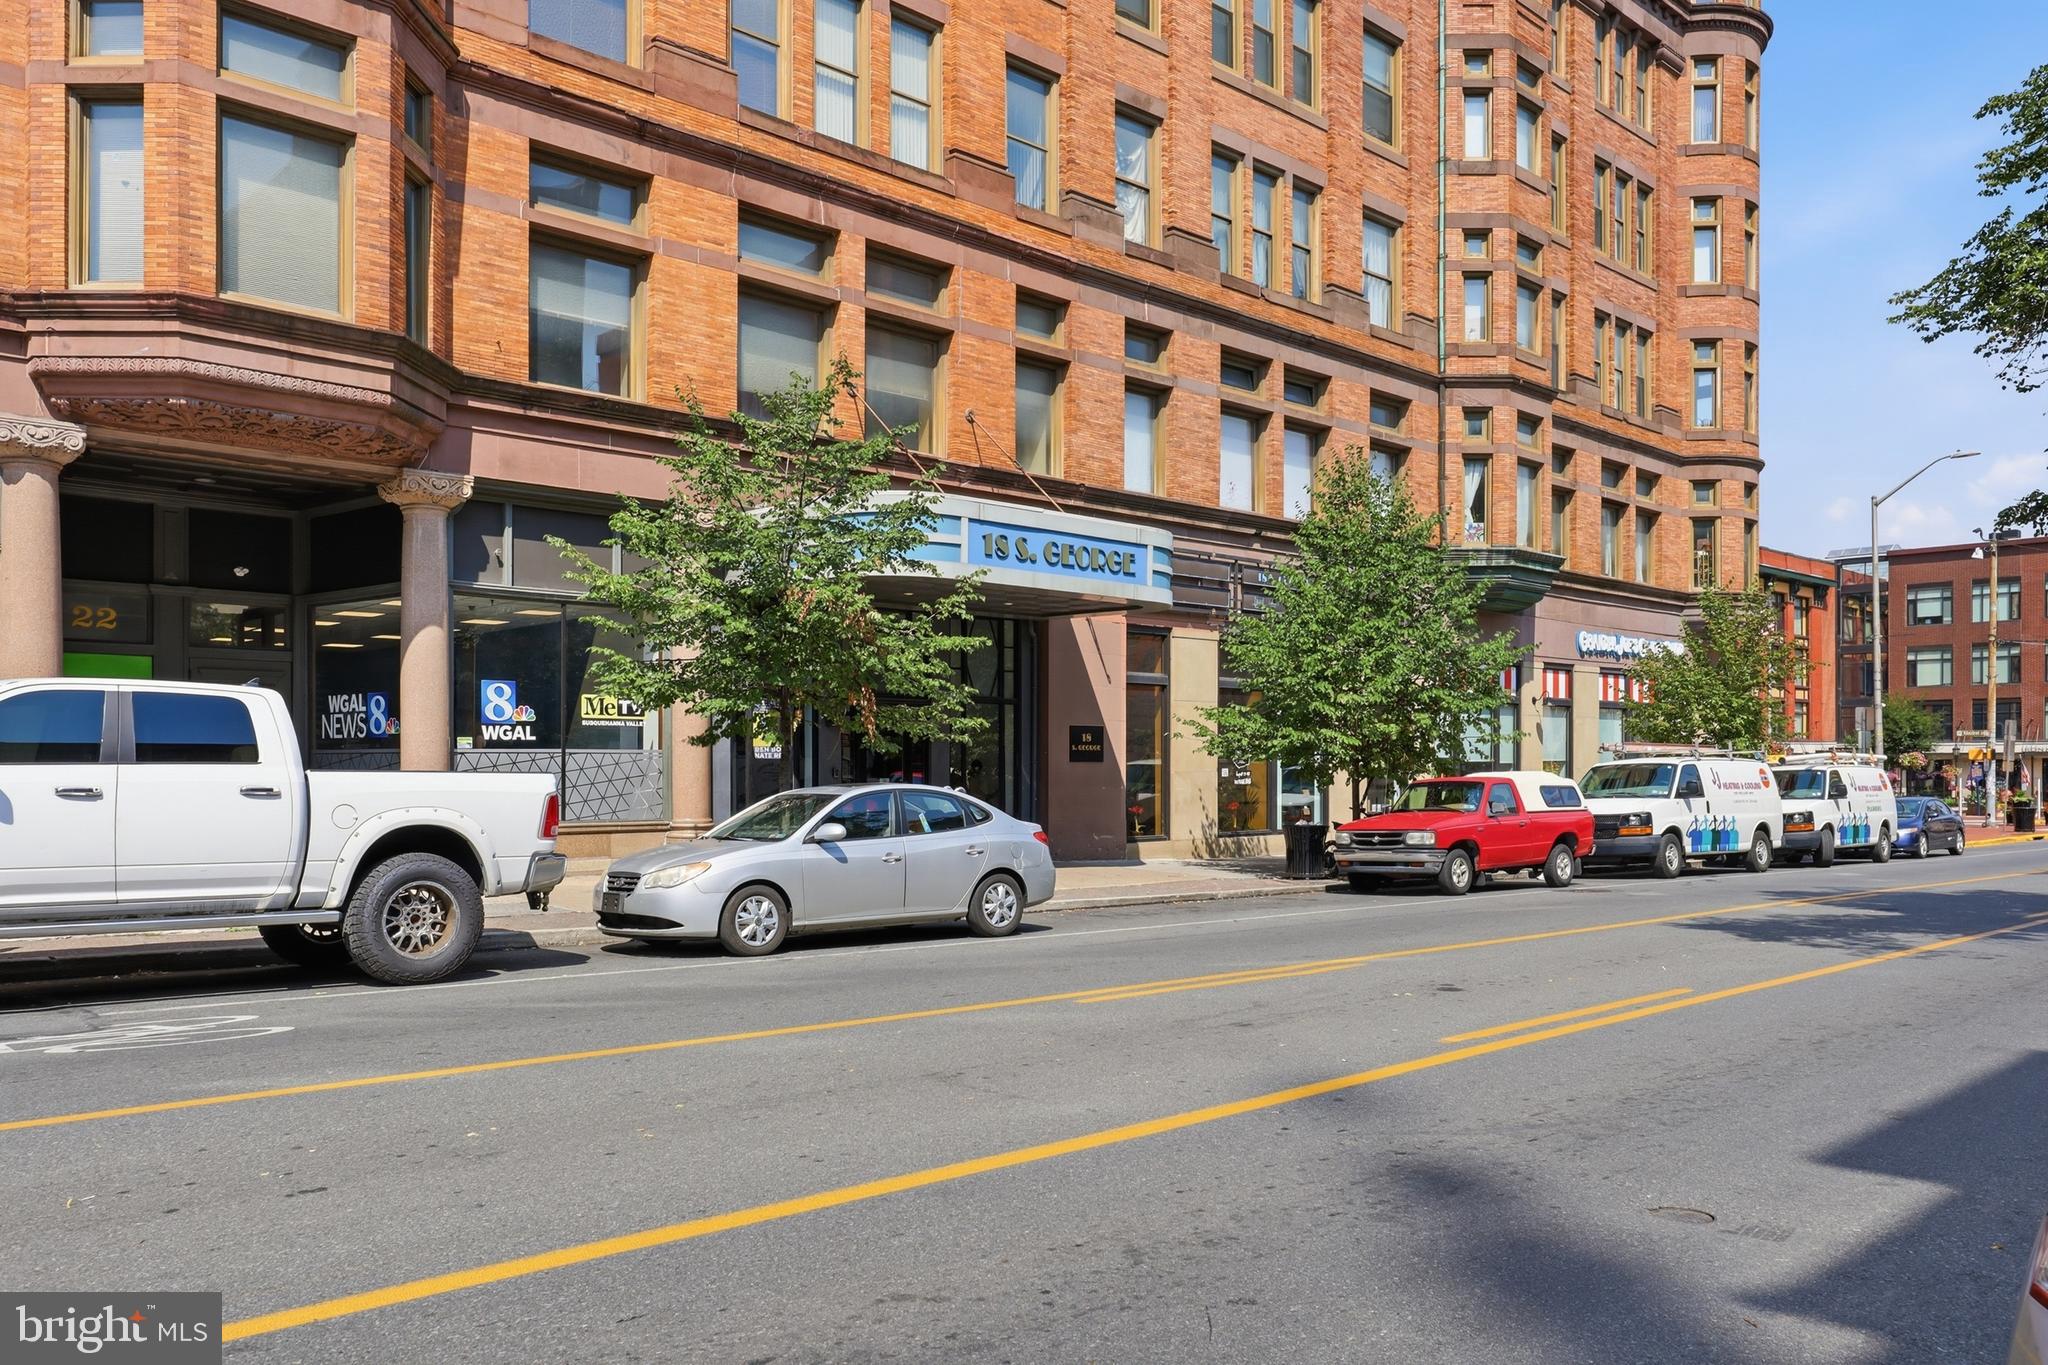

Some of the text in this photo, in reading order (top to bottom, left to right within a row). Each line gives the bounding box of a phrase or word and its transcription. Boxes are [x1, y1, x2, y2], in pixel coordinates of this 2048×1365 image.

[982, 533, 1136, 577] 18 S. GEORGE
[72, 606, 117, 629] 22
[328, 693, 387, 735] WGAL 8
[484, 683, 513, 721] 8
[321, 712, 367, 739] NEWS
[481, 725, 537, 741] WGAL
[1081, 733, 1092, 742] 18
